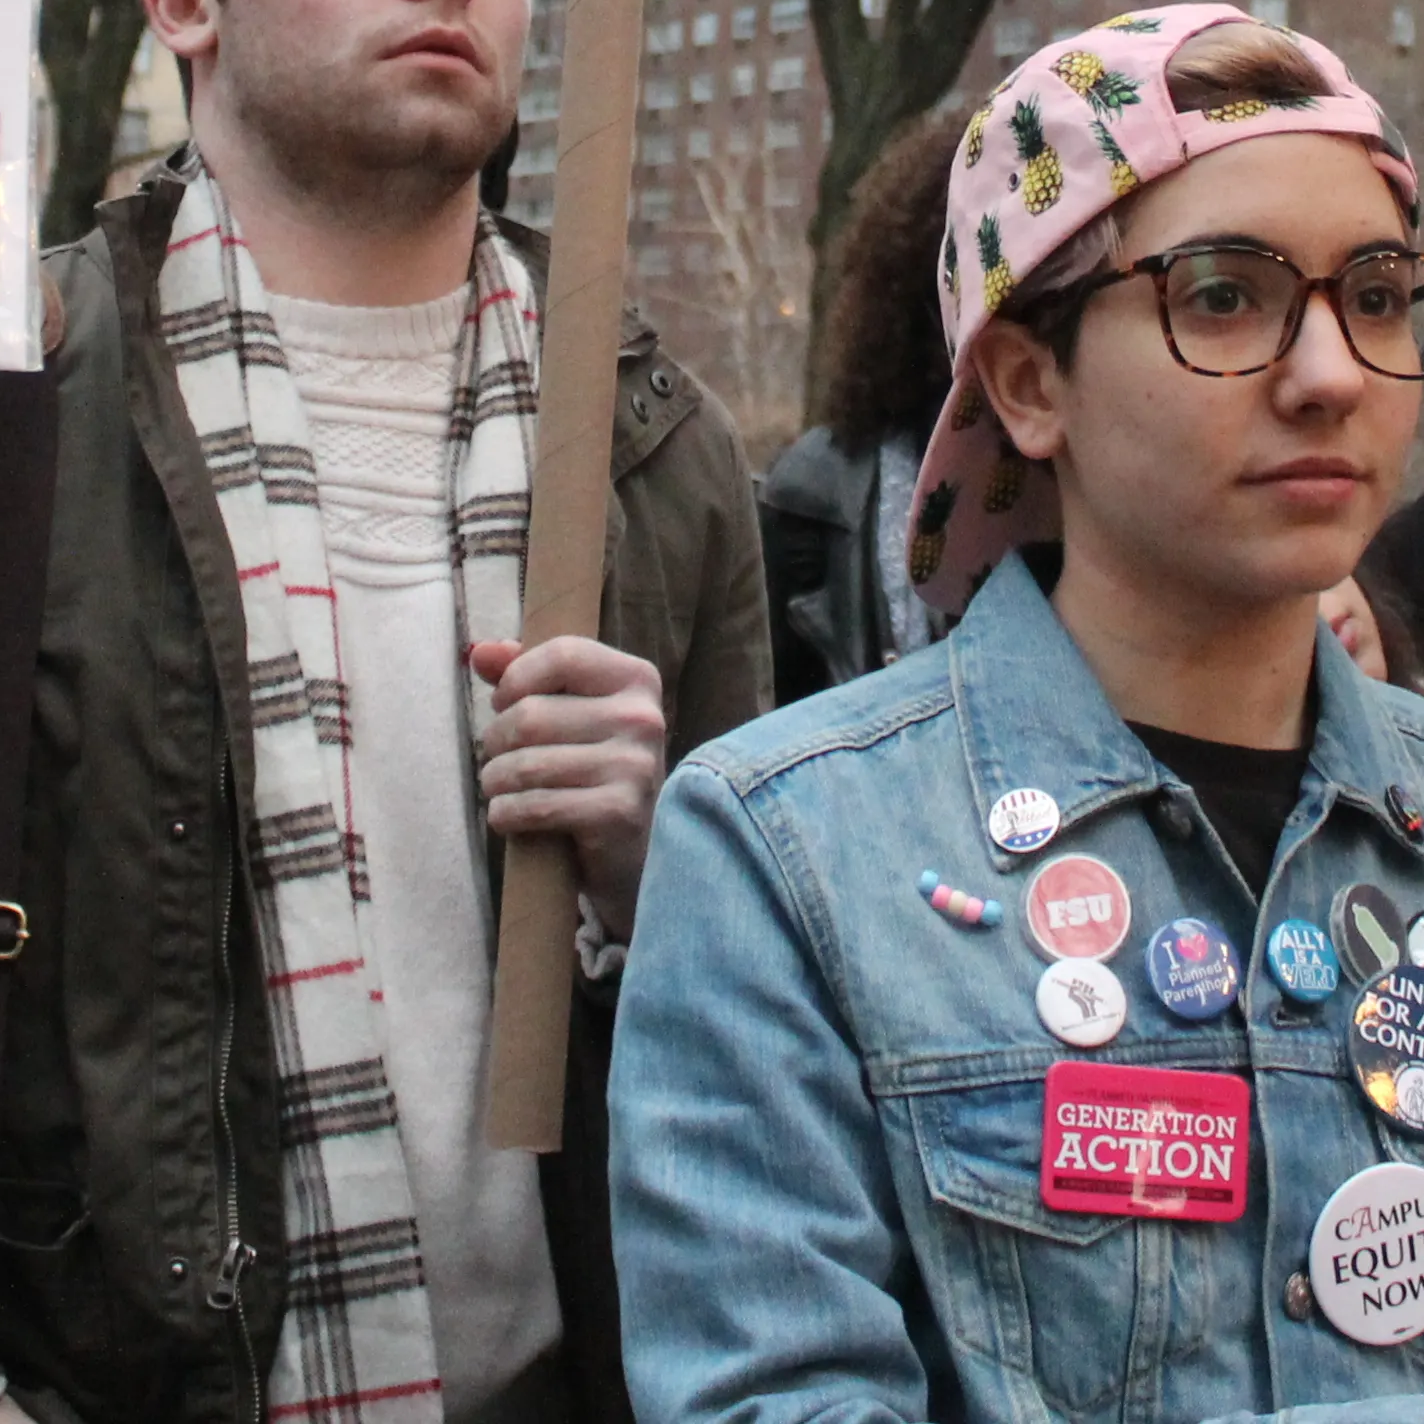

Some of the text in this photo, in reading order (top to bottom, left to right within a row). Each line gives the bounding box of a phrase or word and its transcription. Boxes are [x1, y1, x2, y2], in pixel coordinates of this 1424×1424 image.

[1045, 892, 1114, 930] FSU
[1161, 939, 1181, 971] I
[1282, 929, 1326, 952] ALLY
[1294, 948, 1323, 966] IS A
[1168, 958, 1224, 989] Planned
[1057, 1102, 1237, 1140] GENERATION
[1053, 1131, 1236, 1182] ACTION
